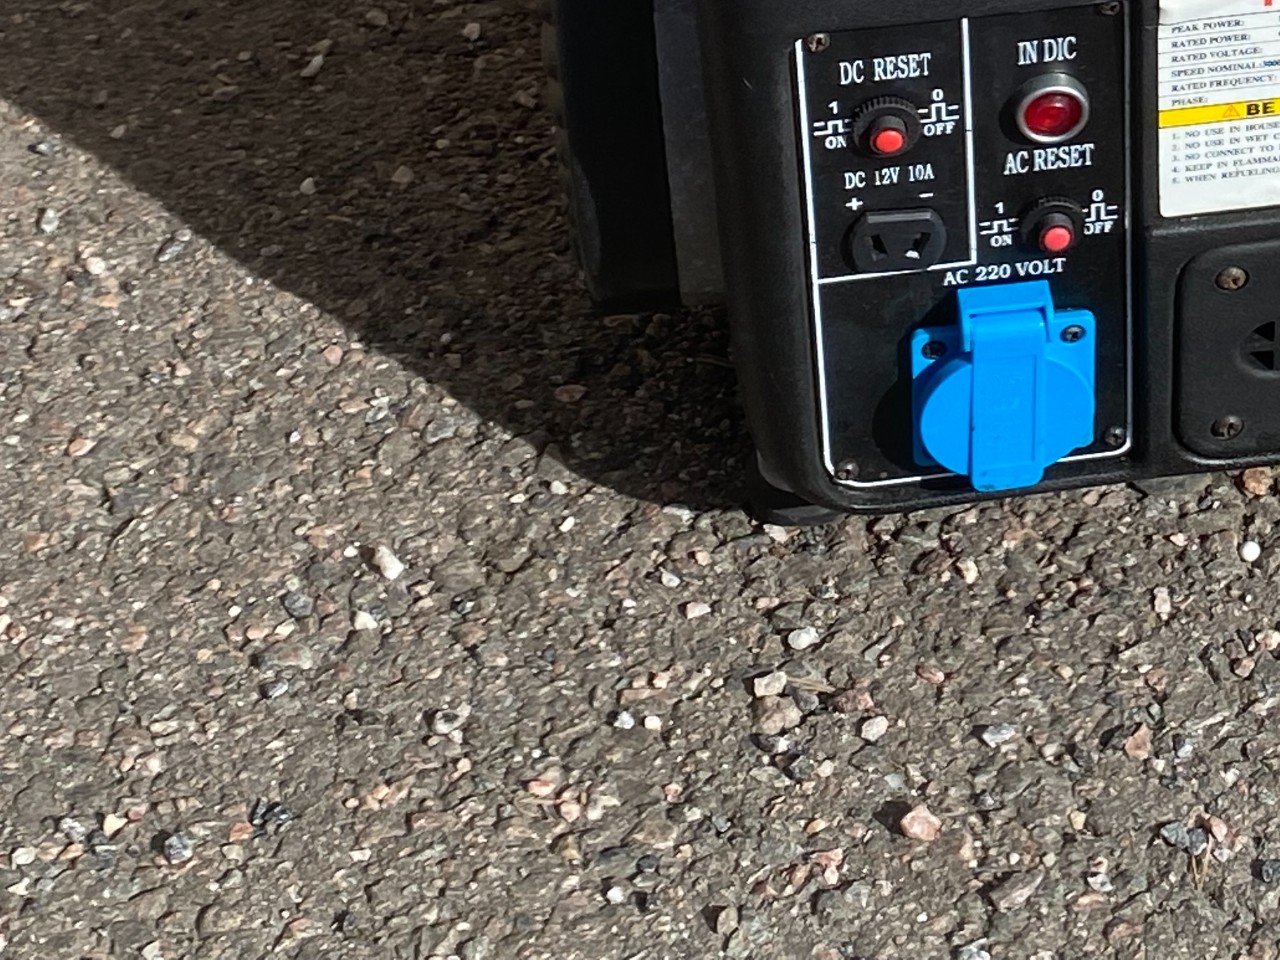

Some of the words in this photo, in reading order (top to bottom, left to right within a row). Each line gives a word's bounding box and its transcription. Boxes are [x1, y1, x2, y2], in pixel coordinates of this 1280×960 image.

[1171, 25, 1199, 34] PEAK
[1203, 19, 1244, 31] POWER:
[1171, 37, 1207, 48] RATED
[1210, 34, 1251, 44] POWER:
[1017, 41, 1039, 65] IN
[1042, 36, 1078, 62] DIC
[1171, 52, 1207, 63] RATED
[1210, 47, 1263, 59] VOLTAGE:
[839, 60, 865, 85] DC
[873, 53, 932, 81] RESET
[1171, 67, 1205, 78] SPEED
[1171, 81, 1207, 92] RATED
[1210, 75, 1277, 88] FREQUENCY:
[1171, 96, 1208, 107] PHASE:
[1246, 102, 1275, 117] BE
[924, 122, 956, 137] OFF
[1185, 130, 1201, 139] NO
[1204, 128, 1225, 136] USE
[1246, 121, 1280, 132] HOUSE
[825, 136, 847, 149] ON
[1185, 142, 1201, 150] NO
[1204, 139, 1225, 147] USE
[1245, 134, 1269, 143] WET
[1003, 151, 1030, 175] AC
[1033, 143, 1095, 172] RESET
[1185, 153, 1201, 161] NO
[1204, 147, 1255, 159] CONNECT
[1260, 145, 1275, 153] TO
[1185, 163, 1213, 173] KEEP
[845, 171, 866, 189] DC
[874, 167, 900, 186] 12V
[909, 163, 934, 182] 10A
[1185, 173, 1217, 183] WHEN
[1083, 221, 1114, 235] OFF
[990, 234, 1012, 247] ON
[943, 269, 969, 287] AC
[975, 264, 1011, 282] 220
[1015, 257, 1067, 277] VOLT
